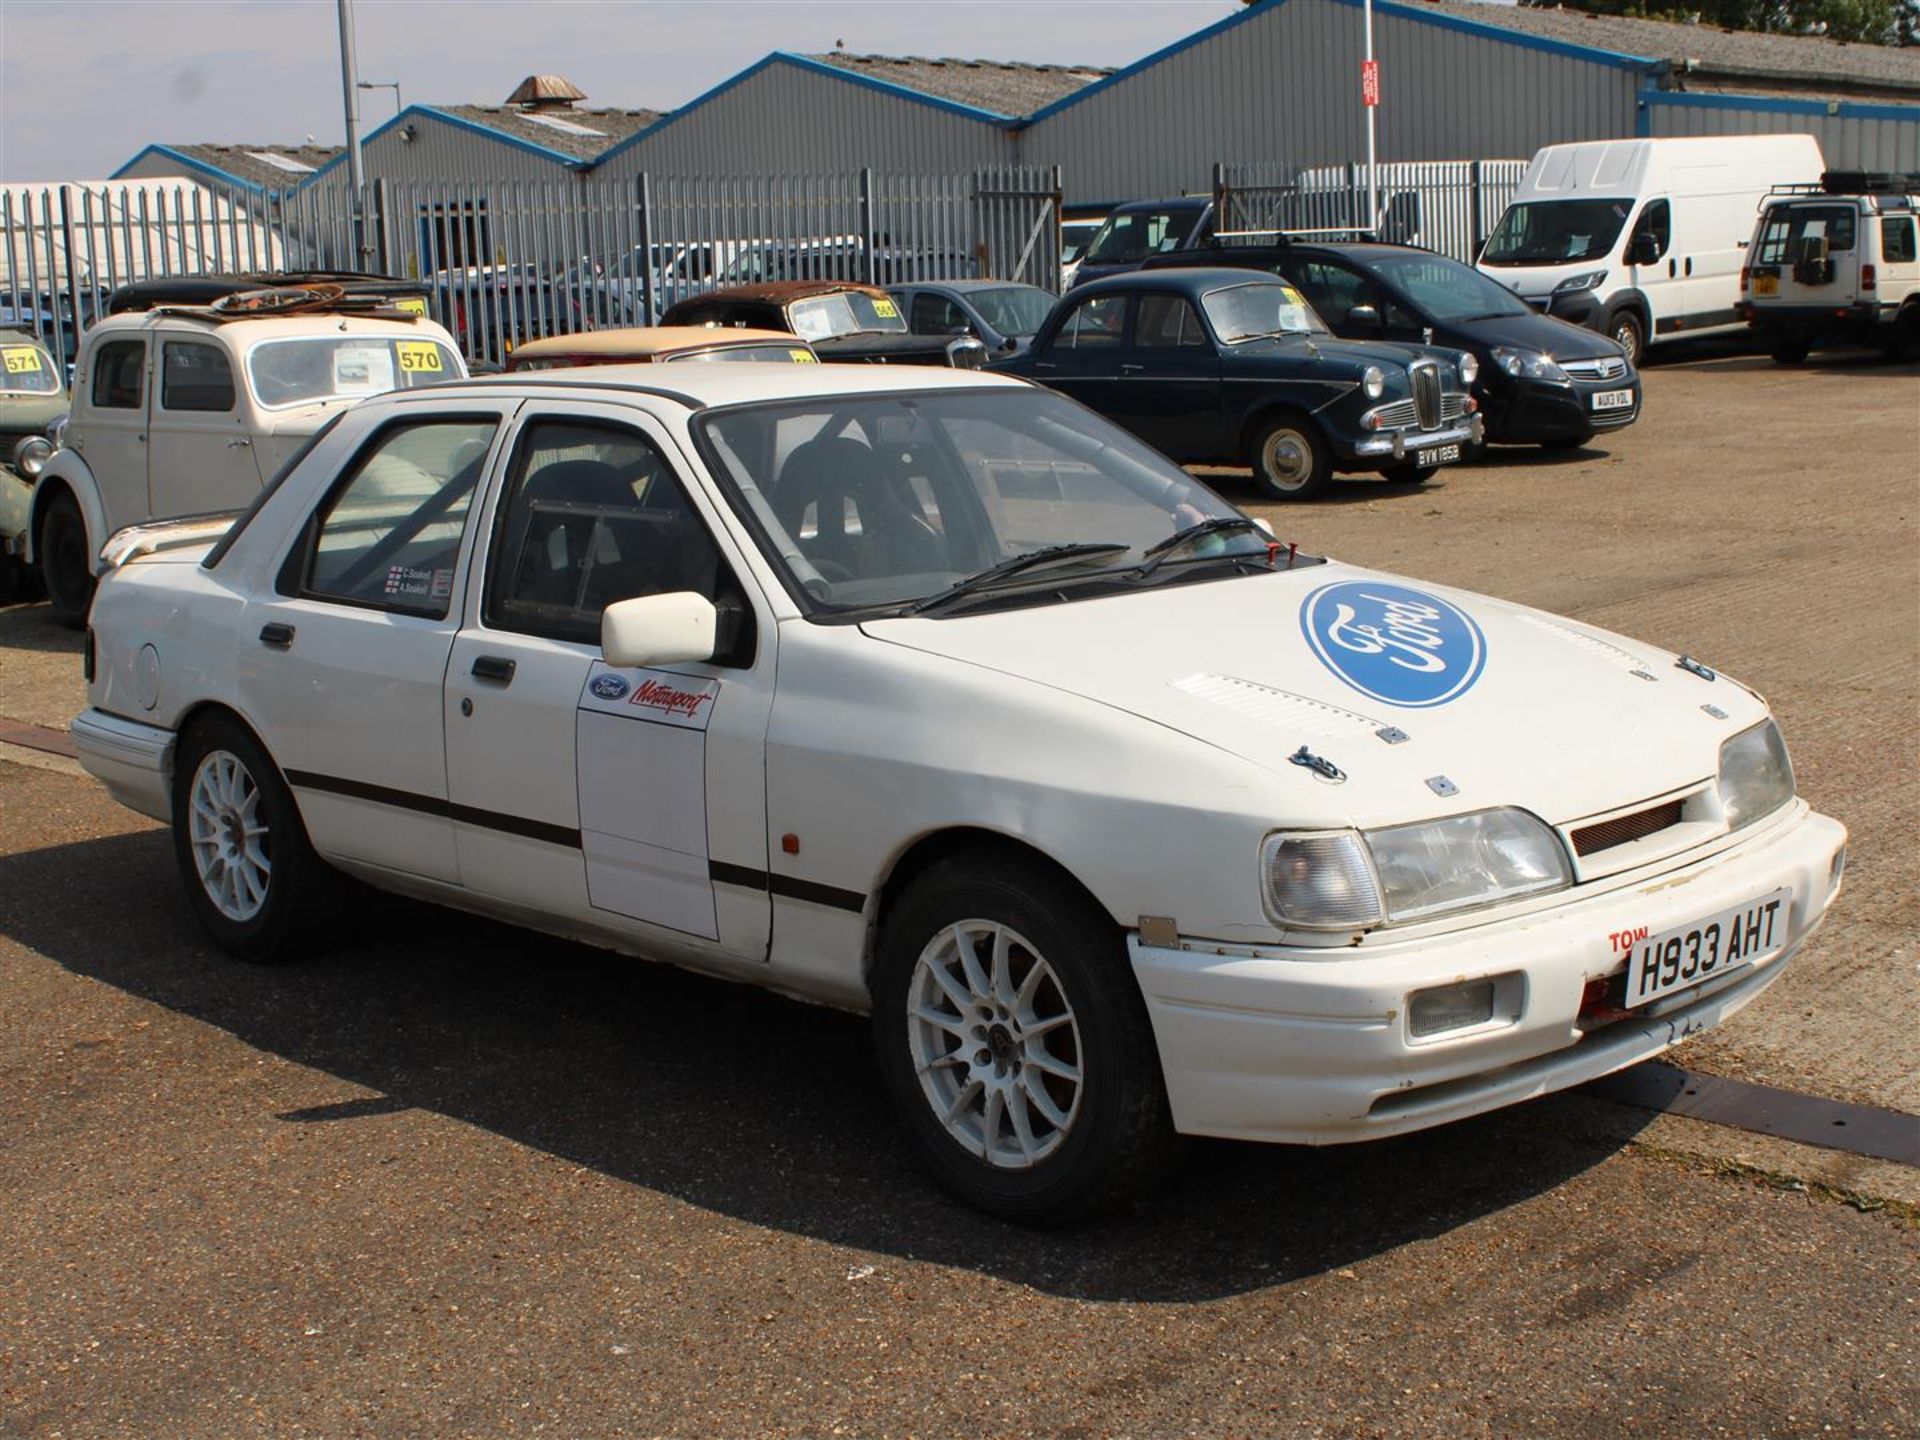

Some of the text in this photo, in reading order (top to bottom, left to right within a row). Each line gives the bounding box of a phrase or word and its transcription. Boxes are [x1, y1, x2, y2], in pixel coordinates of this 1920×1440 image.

[7, 355, 38, 370] 571
[401, 352, 440, 369] 570
[1598, 393, 1615, 407] AU13
[1419, 448, 1438, 465] BVW
[1328, 593, 1447, 673] Ford
[595, 678, 713, 718] Ford Motorsport
[1608, 926, 1649, 952] TOW
[1639, 899, 1781, 996] H933 AHT
